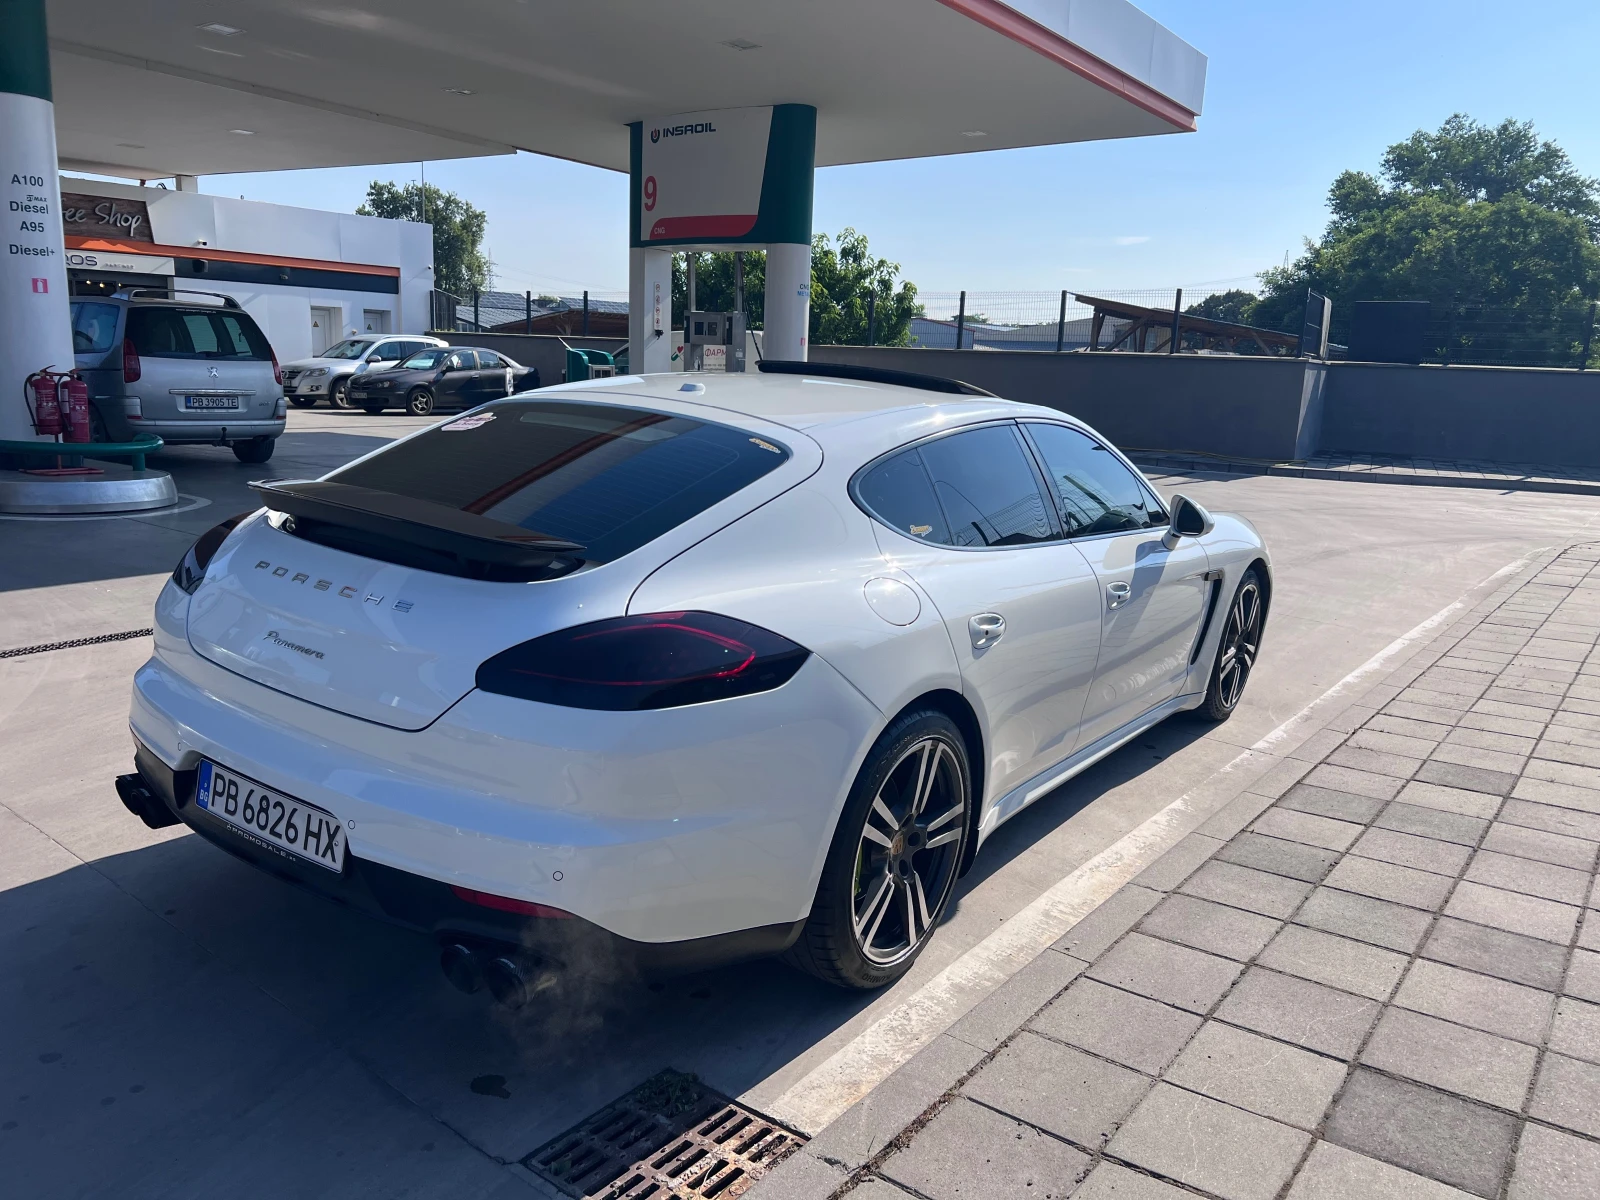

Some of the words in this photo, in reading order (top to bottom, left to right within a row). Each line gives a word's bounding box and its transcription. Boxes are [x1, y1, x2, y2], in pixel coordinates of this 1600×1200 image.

[662, 122, 717, 138] INSAOIL
[11, 173, 44, 187] A100
[643, 175, 658, 212] 9
[9, 200, 49, 215] Diesel
[19, 220, 45, 233] A95
[94, 202, 142, 237] Shop
[653, 226, 666, 235] CNG
[9, 243, 56, 257] Diesel+
[192, 397, 204, 407] PB
[204, 397, 226, 407] 3905
[225, 398, 237, 407] TE
[254, 560, 414, 614] PORSCHE
[263, 630, 326, 660] Panamera
[199, 788, 209, 802] BG
[211, 771, 239, 817] PB
[242, 788, 299, 845] 6826
[303, 813, 341, 864] HX
